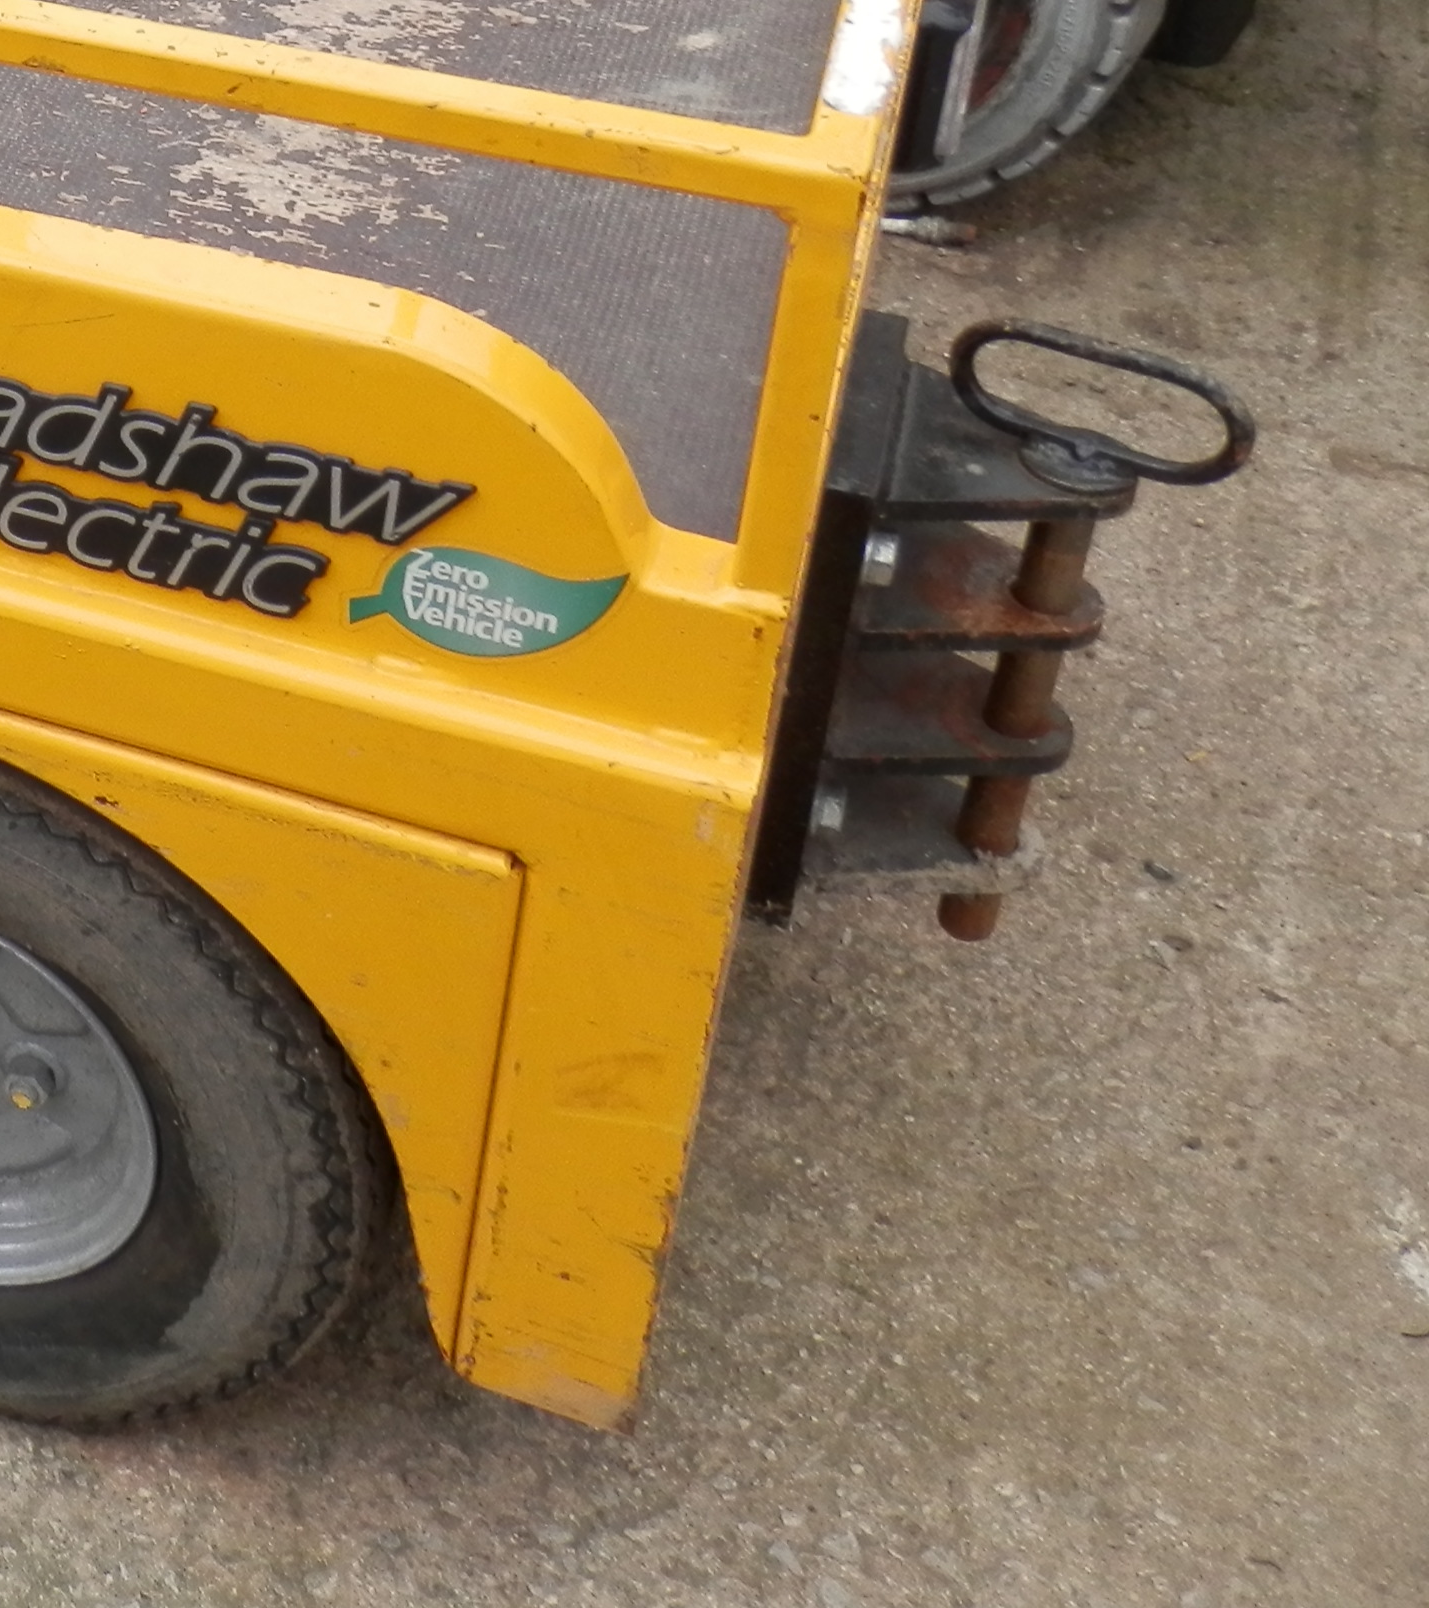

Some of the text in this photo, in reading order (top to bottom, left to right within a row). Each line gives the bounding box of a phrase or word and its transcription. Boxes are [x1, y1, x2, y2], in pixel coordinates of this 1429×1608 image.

[407, 547, 490, 590] Zero
[402, 569, 559, 634] Emission
[403, 593, 524, 648] Vehicle
